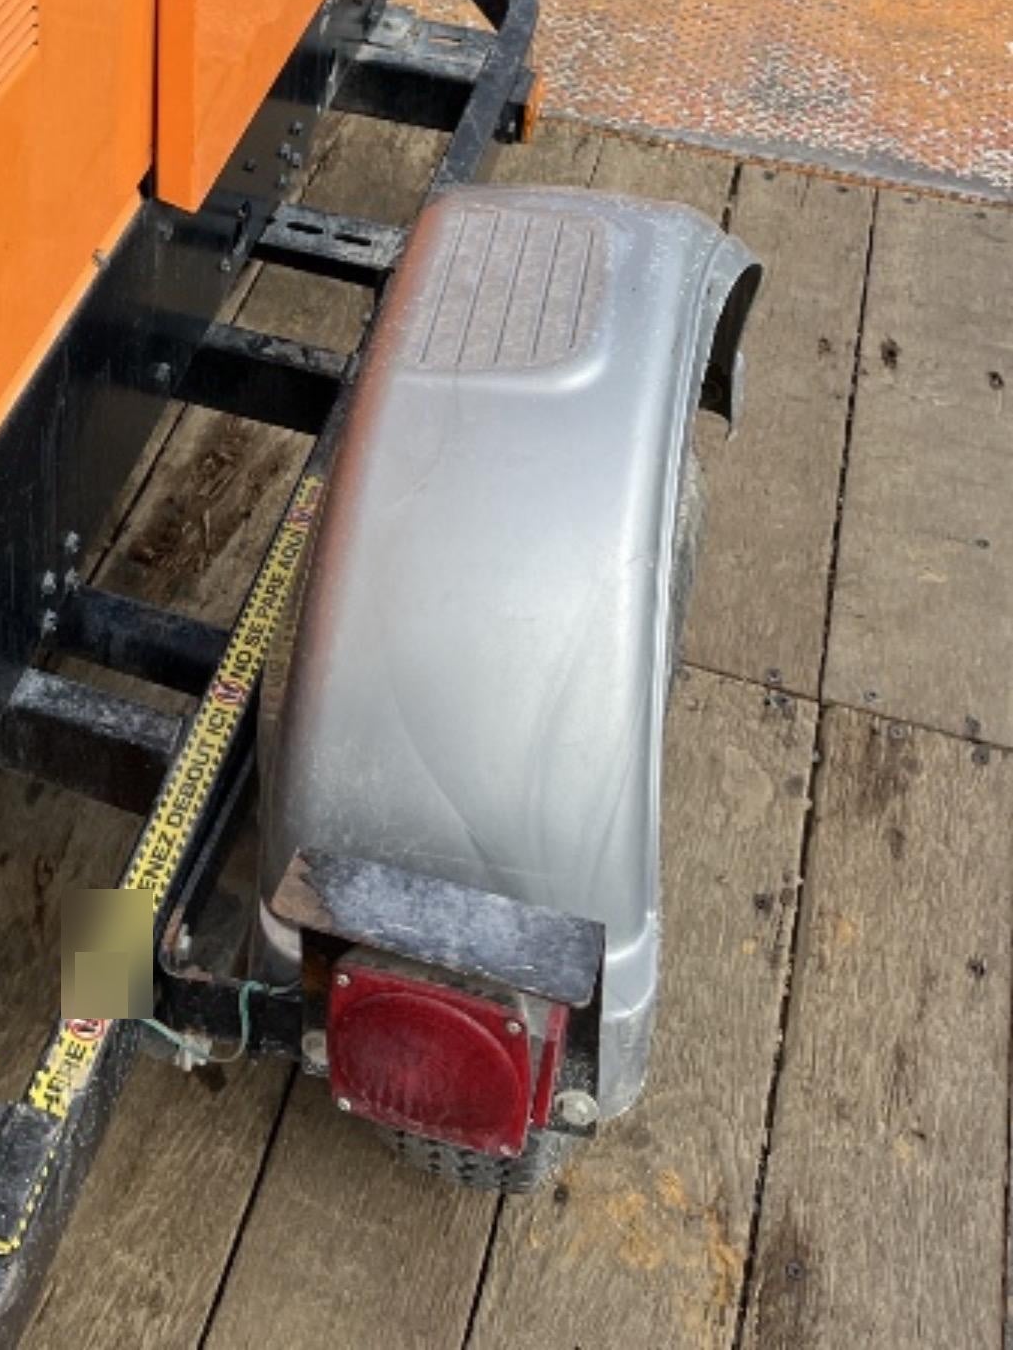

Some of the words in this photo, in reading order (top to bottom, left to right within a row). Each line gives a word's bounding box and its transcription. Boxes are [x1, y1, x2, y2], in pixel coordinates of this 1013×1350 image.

[230, 650, 252, 679] NO
[245, 620, 266, 650] SE
[257, 573, 285, 621] PARE
[138, 831, 177, 890] ENEZ
[166, 737, 215, 828] DEBOUT
[206, 707, 229, 736] ICI
